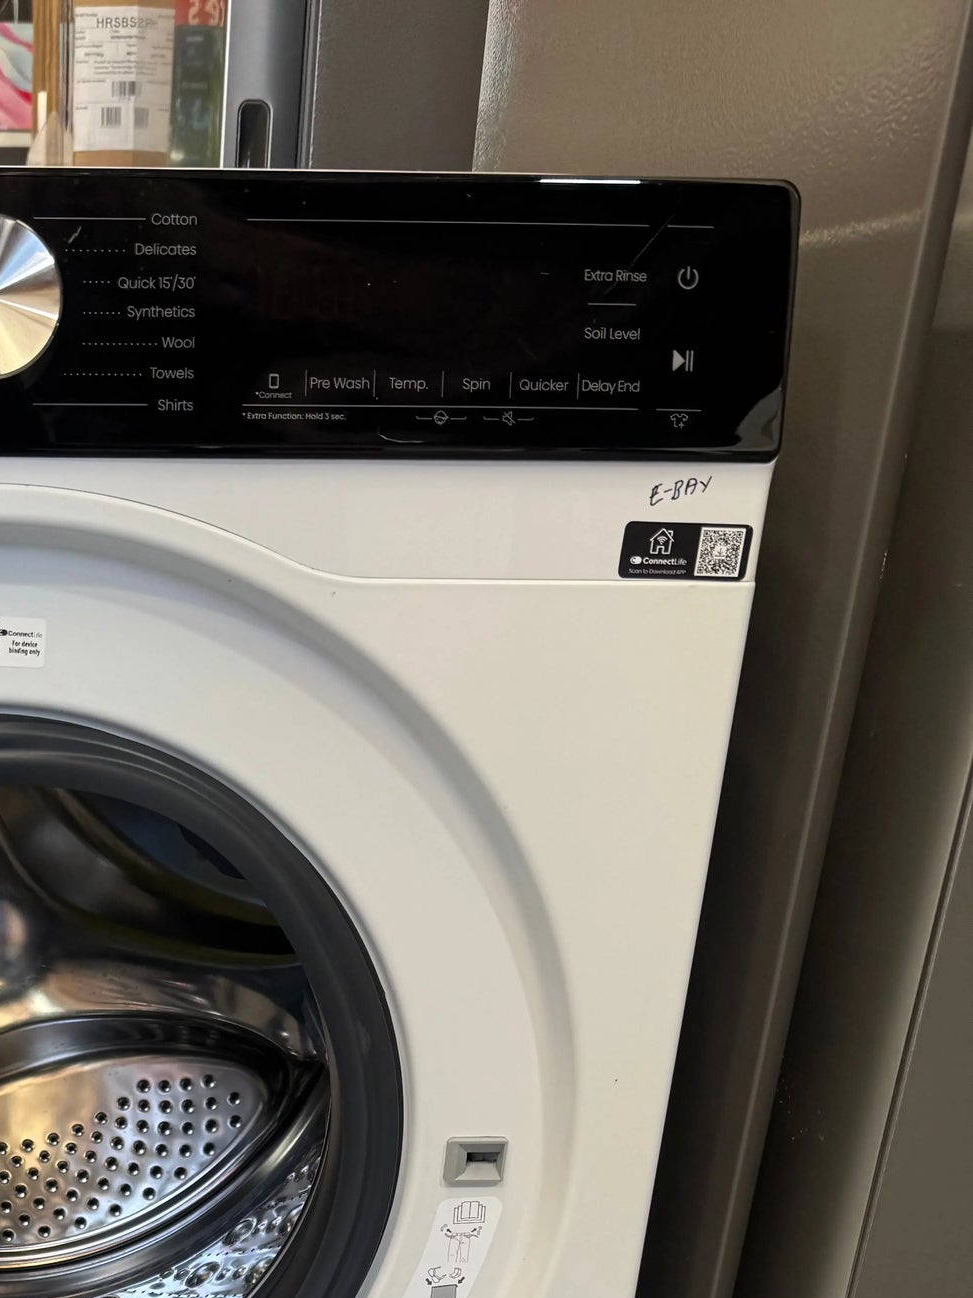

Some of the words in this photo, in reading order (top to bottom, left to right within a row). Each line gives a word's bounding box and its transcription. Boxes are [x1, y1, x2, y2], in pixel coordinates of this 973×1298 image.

[151, 213, 198, 226] Cotton
[134, 243, 197, 256] Delicates
[584, 268, 613, 282] Extra
[615, 269, 647, 282] Rinse
[117, 276, 156, 289] Quick
[127, 306, 196, 320] Synthetics
[584, 327, 607, 340] Soil
[609, 328, 641, 340] Level
[161, 337, 195, 349] Wool
[150, 367, 194, 379] Towels
[309, 377, 331, 389] Pre
[333, 377, 370, 389] Wash
[389, 377, 429, 392] Temp.
[462, 378, 491, 392] Spin
[519, 379, 569, 392] Quicker
[581, 380, 616, 395] Delay
[617, 381, 640, 393] End
[157, 399, 194, 411] Shirts
[247, 412, 267, 420] Extra
[642, 557, 687, 566] ConnectLife
[8, 630, 43, 638] ConnectLife
[11, 639, 21, 647] For
[21, 640, 38, 648] device
[8, 647, 28, 656] binding
[28, 648, 41, 656] only
